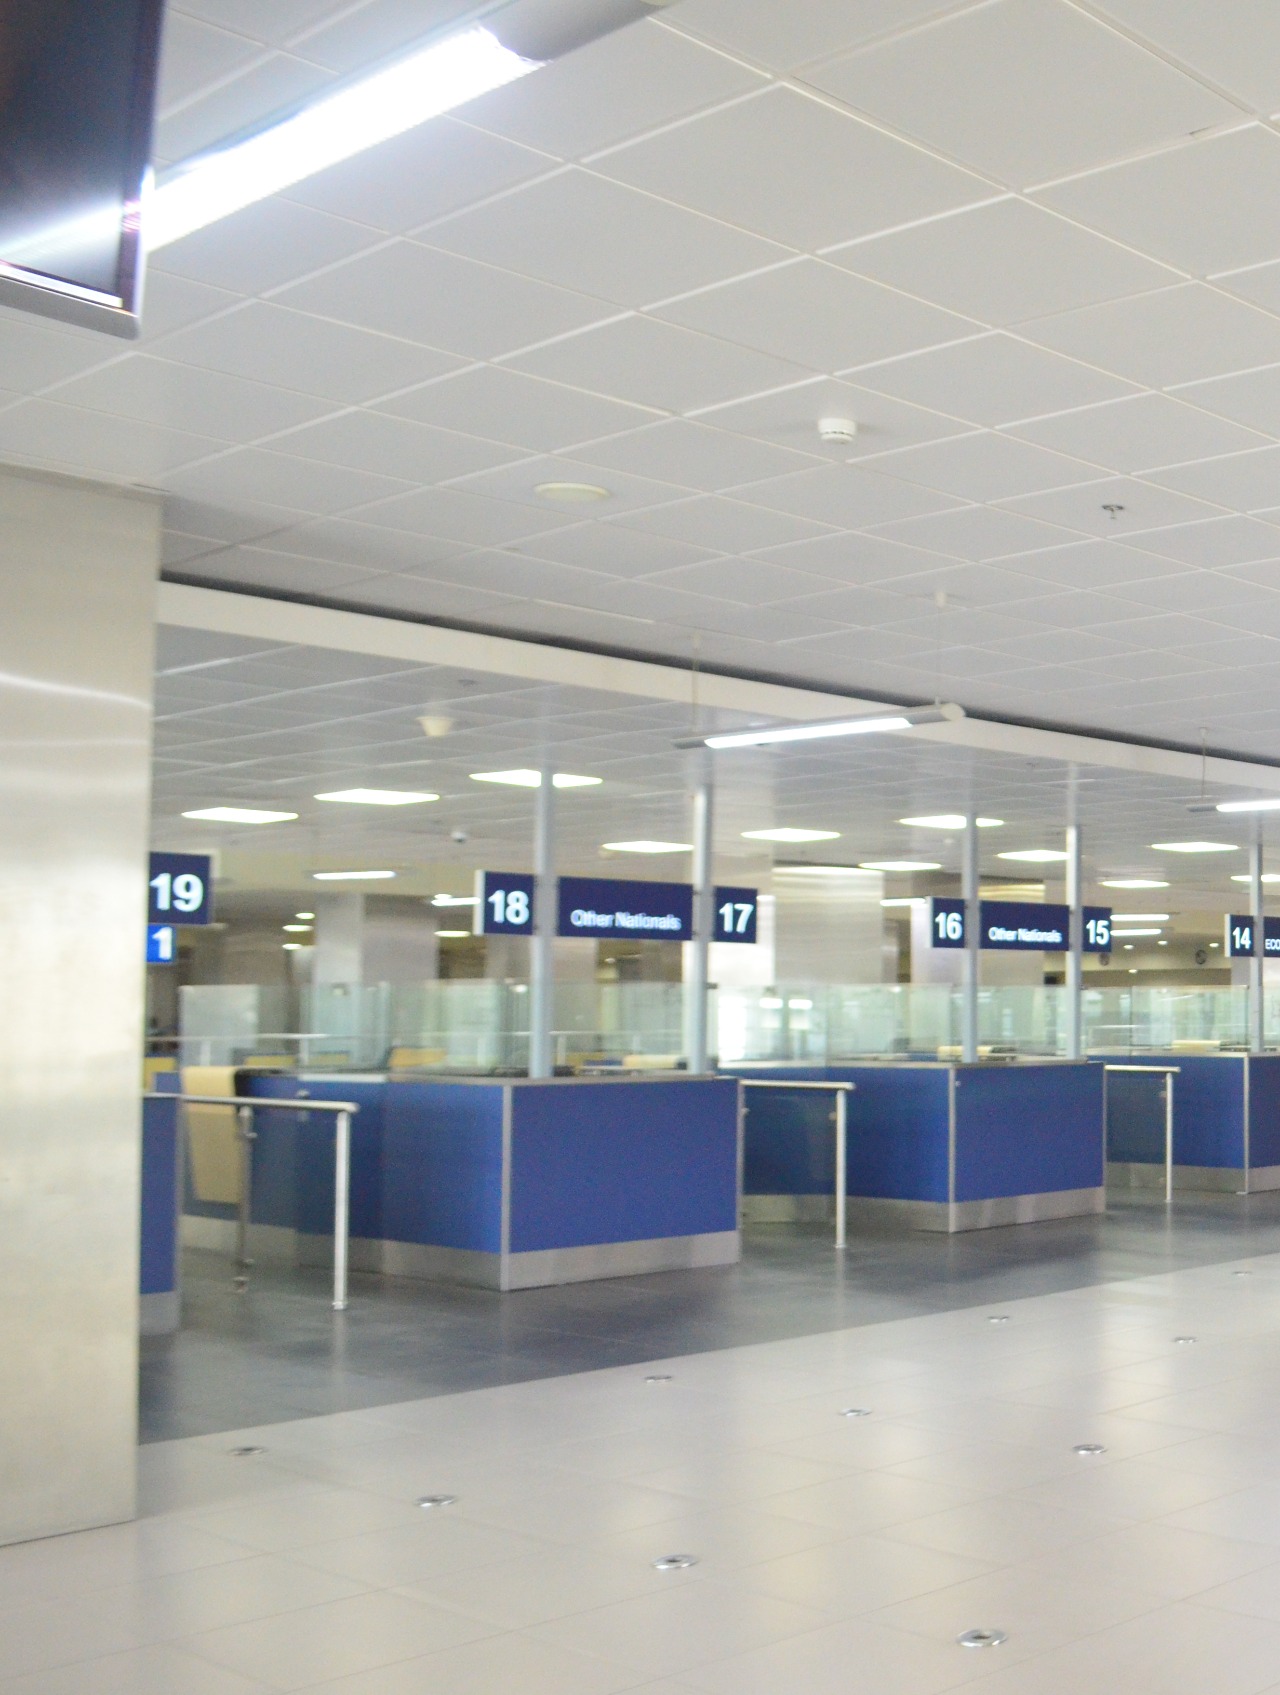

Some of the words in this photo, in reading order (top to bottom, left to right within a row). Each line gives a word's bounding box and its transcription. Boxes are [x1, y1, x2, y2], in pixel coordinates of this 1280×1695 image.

[150, 872, 204, 912] 19
[488, 889, 529, 925] 18
[570, 909, 613, 928] Other
[614, 911, 682, 931] Nationals
[718, 902, 754, 933] 17
[934, 912, 963, 940] 16
[988, 926, 1017, 942] Other
[1017, 928, 1062, 943] Nationals
[1085, 919, 1110, 945] 15
[1232, 926, 1251, 949] 14
